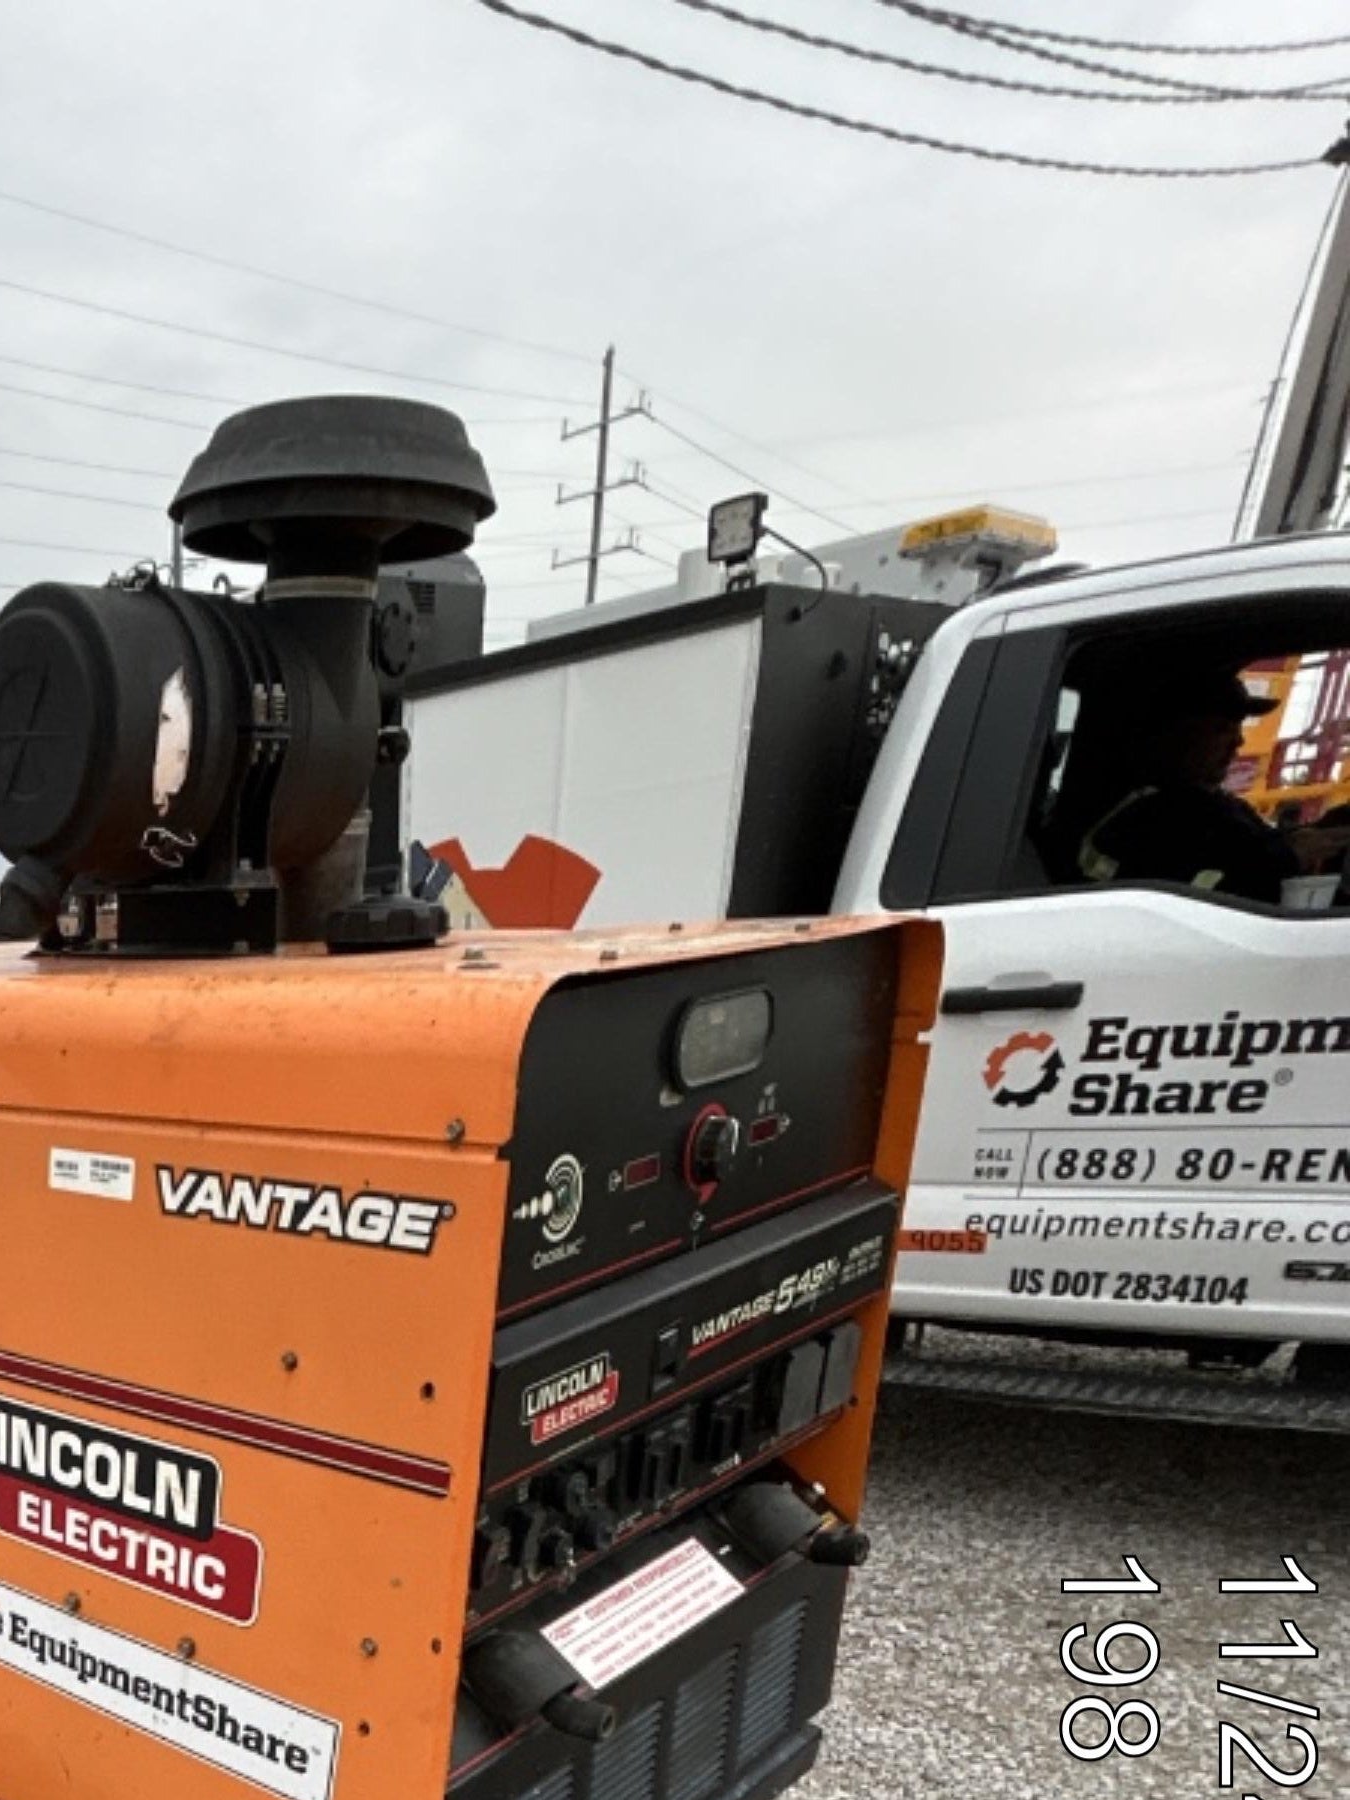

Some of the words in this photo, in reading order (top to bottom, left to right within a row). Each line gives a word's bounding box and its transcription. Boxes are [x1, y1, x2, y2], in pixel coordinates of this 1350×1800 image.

[1080, 1011, 1350, 1070] Equipm
[1068, 1073, 1269, 1116] Share
[974, 1166, 1009, 1180] NOW
[975, 1148, 1014, 1162] CALL
[1037, 1147, 1157, 1183] (888)
[155, 1164, 440, 1255] VANTAGE
[965, 1208, 1350, 1244] equipmentshare.co
[1010, 1268, 1044, 1294] US
[1051, 1269, 1107, 1299] DOT
[1113, 1271, 1249, 1305] 2834104
[692, 1289, 777, 1346] VANTAGE
[527, 1360, 604, 1417] LINCOLN
[543, 1388, 608, 1435] ELECTRIC
[17, 1490, 226, 1600] ELECTRIC
[8, 1611, 310, 1775] EquipmentShare
